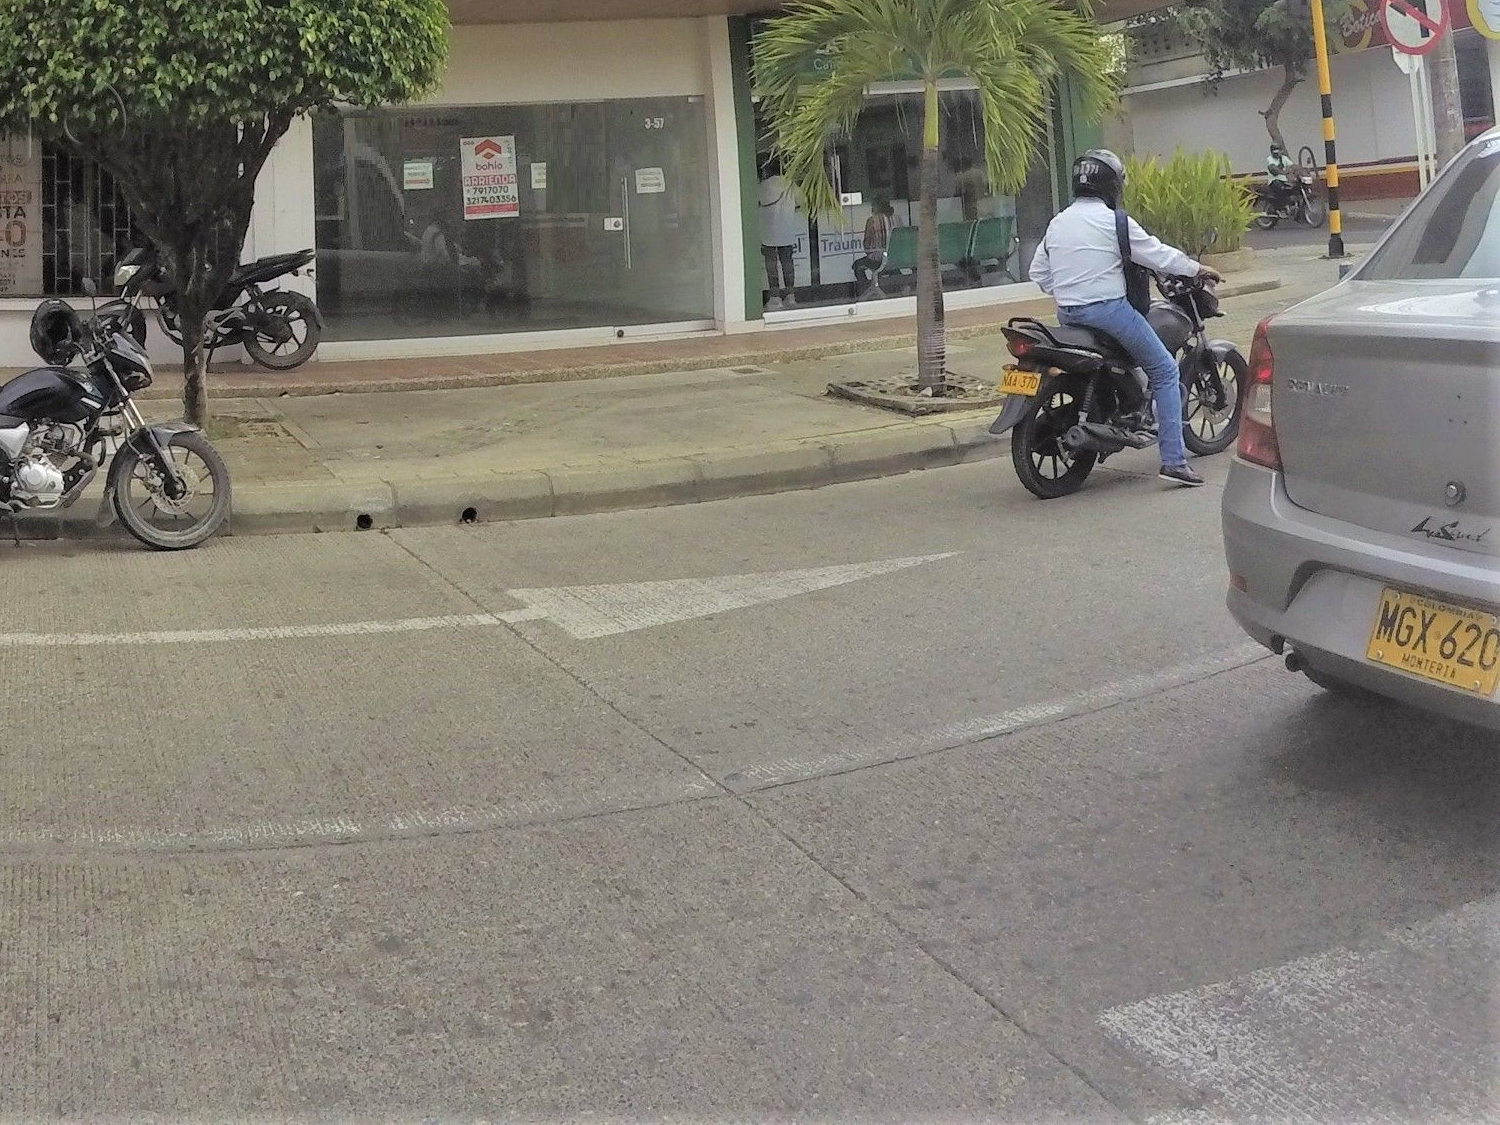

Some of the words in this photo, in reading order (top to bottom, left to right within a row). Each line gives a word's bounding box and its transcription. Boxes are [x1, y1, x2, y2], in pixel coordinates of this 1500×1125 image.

[645, 118, 664, 129] 3-57
[464, 175, 516, 186] ARRIENDA
[473, 186, 509, 195] 7917070
[1376, 600, 1437, 654] MGX
[1439, 619, 1500, 672] 620
[1401, 653, 1456, 679] MONTERIA
